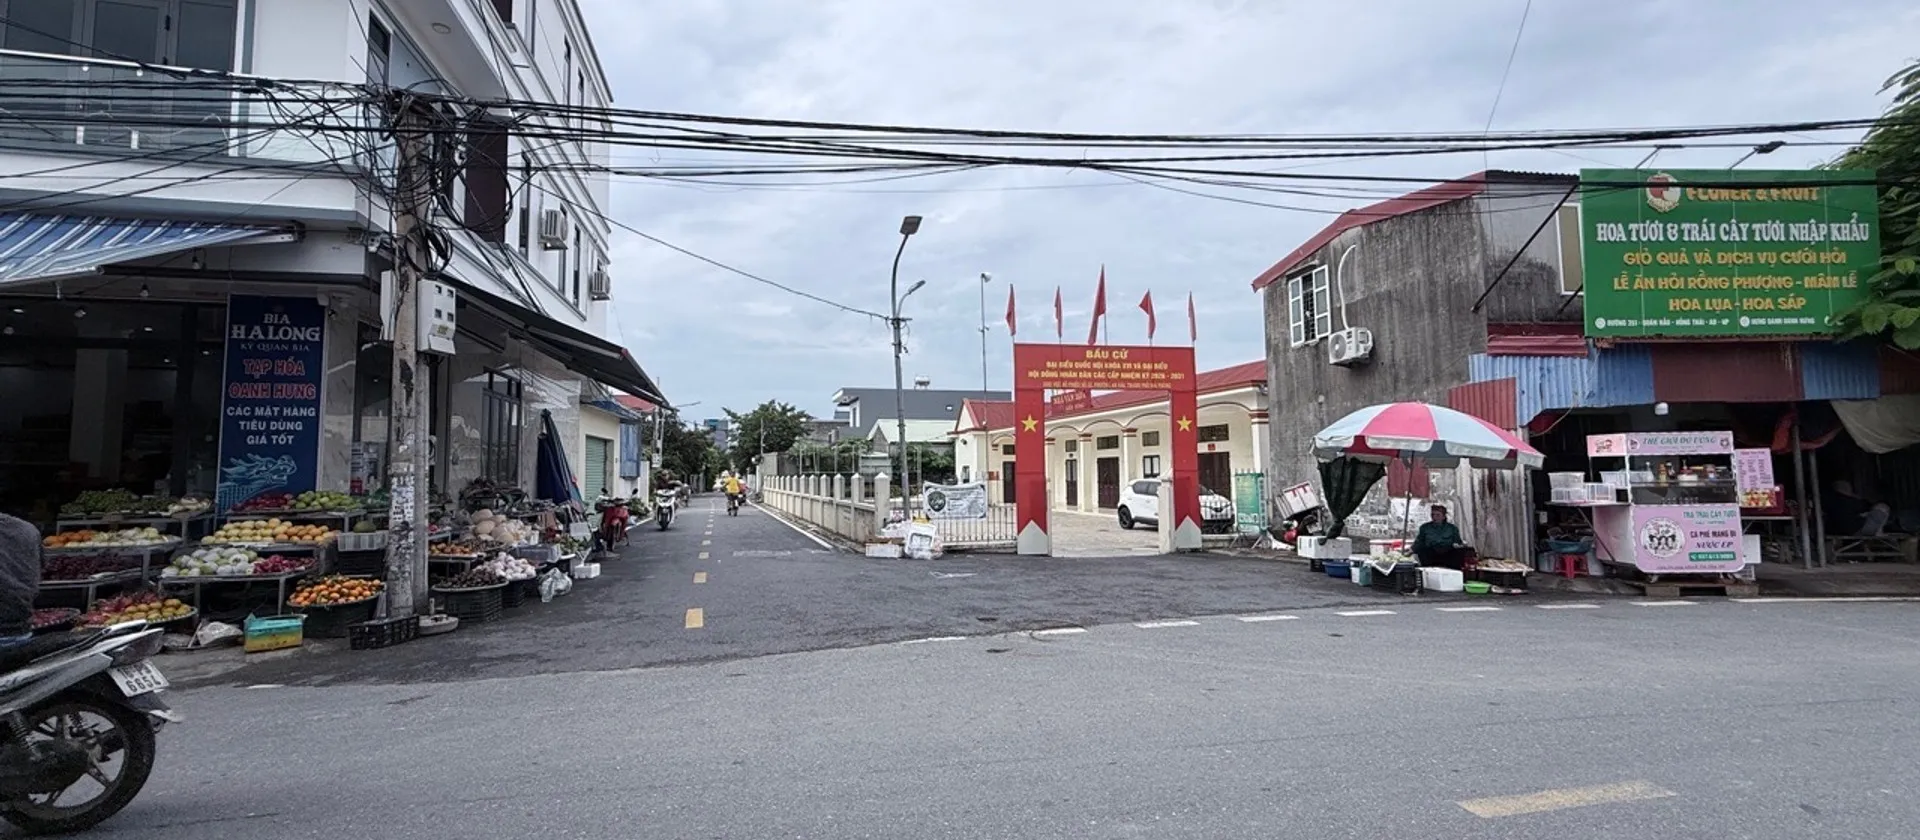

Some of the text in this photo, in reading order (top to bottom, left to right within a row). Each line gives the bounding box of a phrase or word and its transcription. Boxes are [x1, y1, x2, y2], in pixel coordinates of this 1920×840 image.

[1596, 211, 1869, 245] HOA TƯƠI & TRÁI CÂY TƯƠI NHẬP KHẨU
[1623, 246, 1847, 268] GIỎ QUẢ VÀ DỊCH VỤ CƯỚI HỎI
[1613, 271, 1629, 290] LỄ
[1658, 272, 1685, 290] HỎI
[1732, 275, 1794, 292] PHƯỢNG
[1804, 273, 1840, 289] MÂM
[1842, 270, 1858, 289] LỄ
[1669, 298, 1701, 311] HOA
[1705, 298, 1733, 315] LỤA
[1742, 297, 1775, 310] HOA
[1778, 292, 1807, 310] SÁP
[263, 313, 291, 324] BIA
[257, 343, 288, 352] QUAN
[293, 344, 309, 352] BIA
[243, 356, 305, 379] TẠP HÓA
[229, 382, 271, 399] OANH
[226, 404, 316, 418] CÁC MẶT HÀNG
[239, 418, 303, 431] TIÊU DÙNG
[246, 432, 294, 445] GIÁ TỐT
